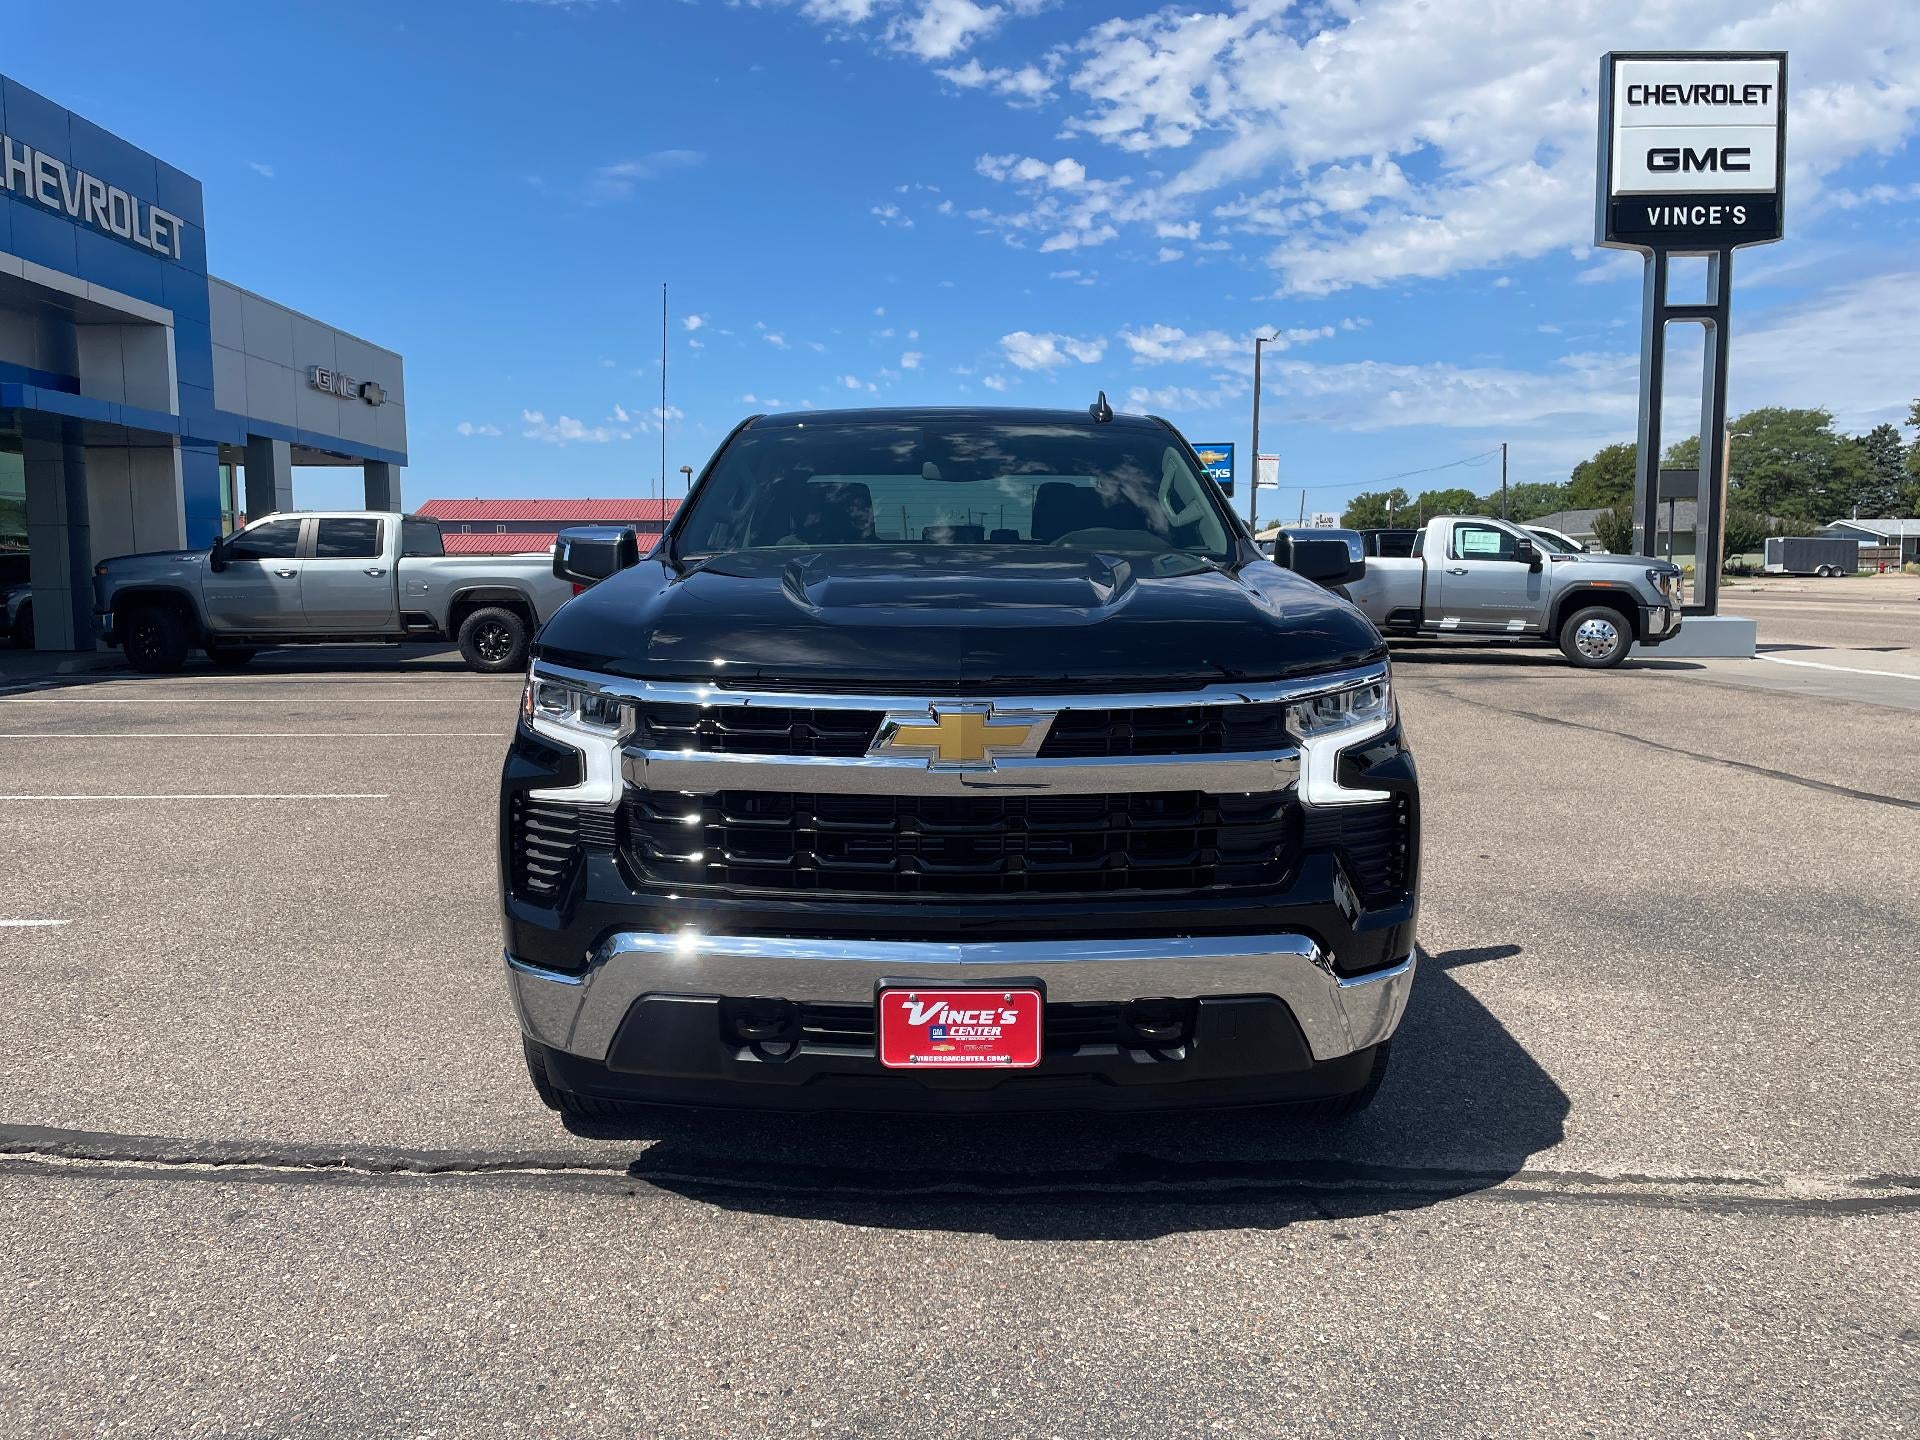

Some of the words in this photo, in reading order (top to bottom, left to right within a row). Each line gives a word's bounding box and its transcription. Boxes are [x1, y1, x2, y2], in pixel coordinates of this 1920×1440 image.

[1627, 84, 1772, 105] CHEVROLET
[1646, 147, 1751, 172] GMC
[0, 133, 184, 260] HEVROLET
[1647, 205, 1747, 226] VINCE'S
[316, 366, 358, 400] GMC
[932, 1028, 943, 1036] GM
[949, 1026, 1002, 1036] CENTER
